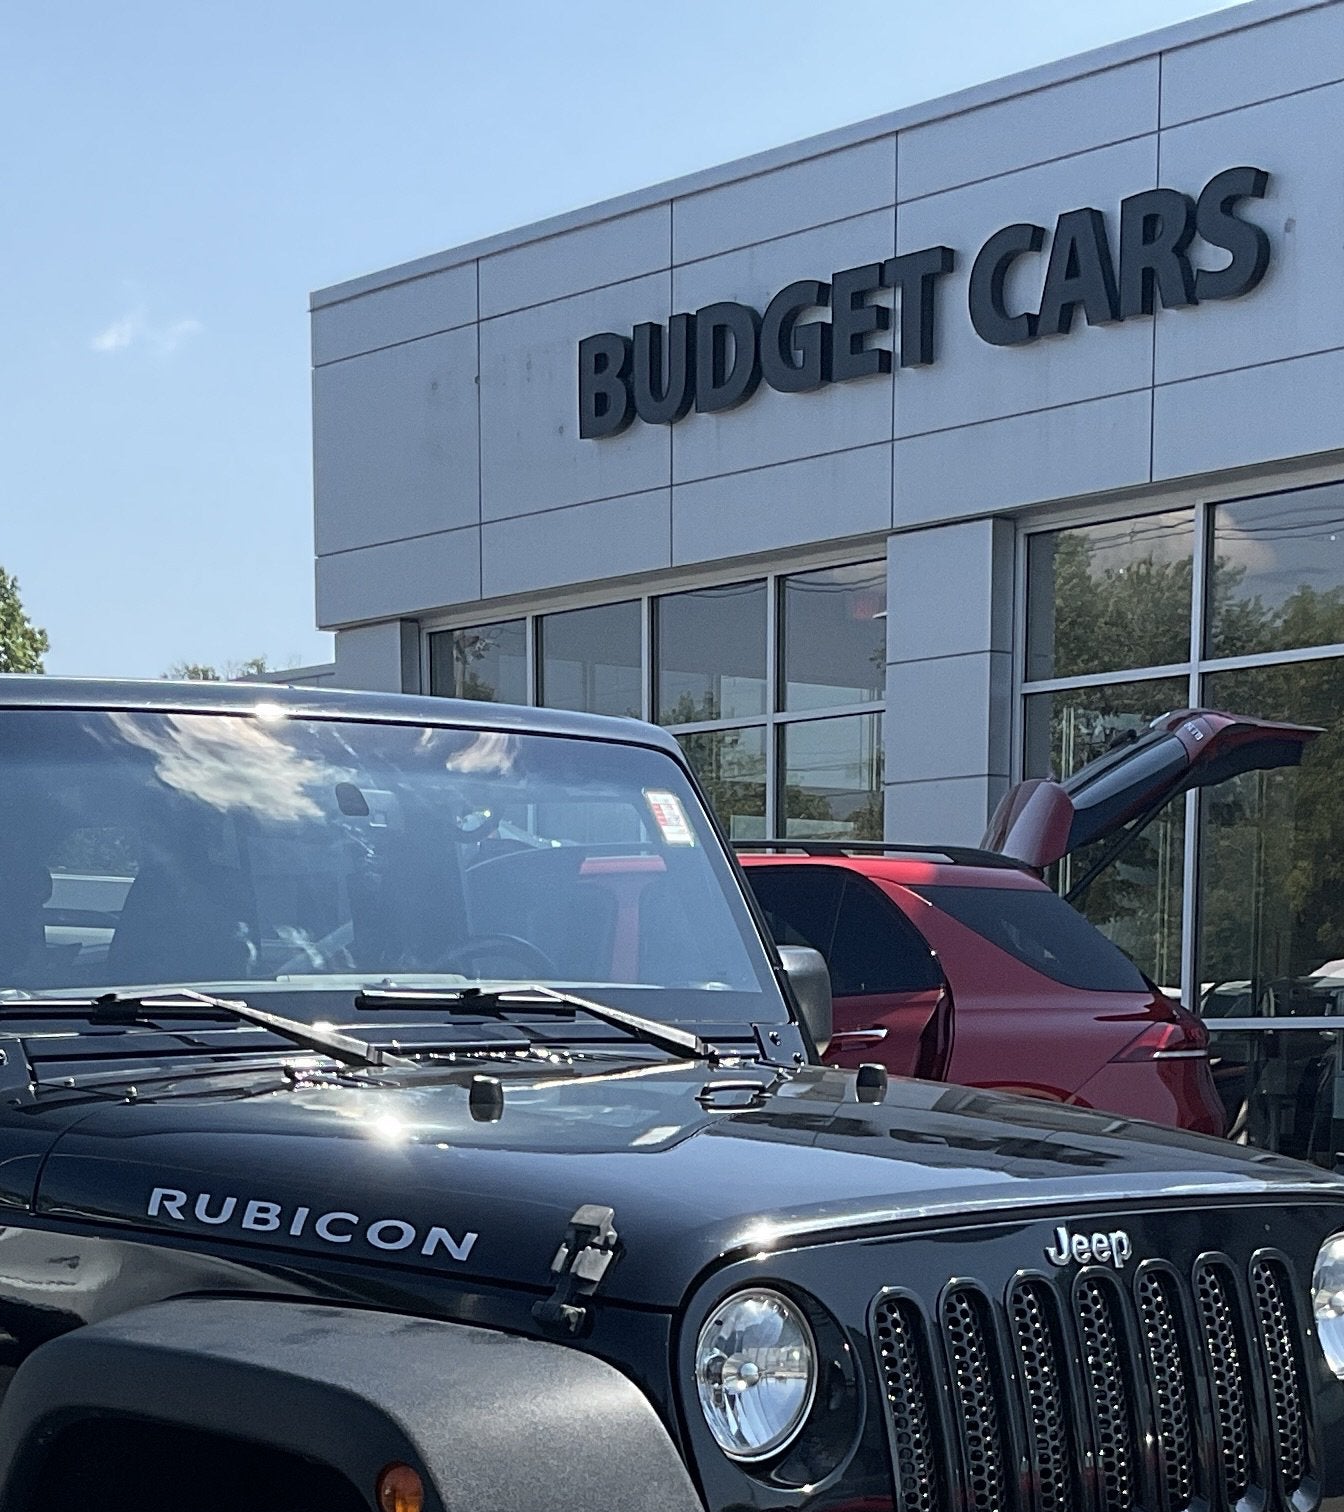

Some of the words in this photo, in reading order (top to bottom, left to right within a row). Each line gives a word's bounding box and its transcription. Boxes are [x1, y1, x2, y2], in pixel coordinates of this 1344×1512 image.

[579, 246, 956, 440] BUDGET
[968, 166, 1272, 347] CARS
[147, 1187, 479, 1262] RUBICON
[1044, 1226, 1133, 1269] Jeep
